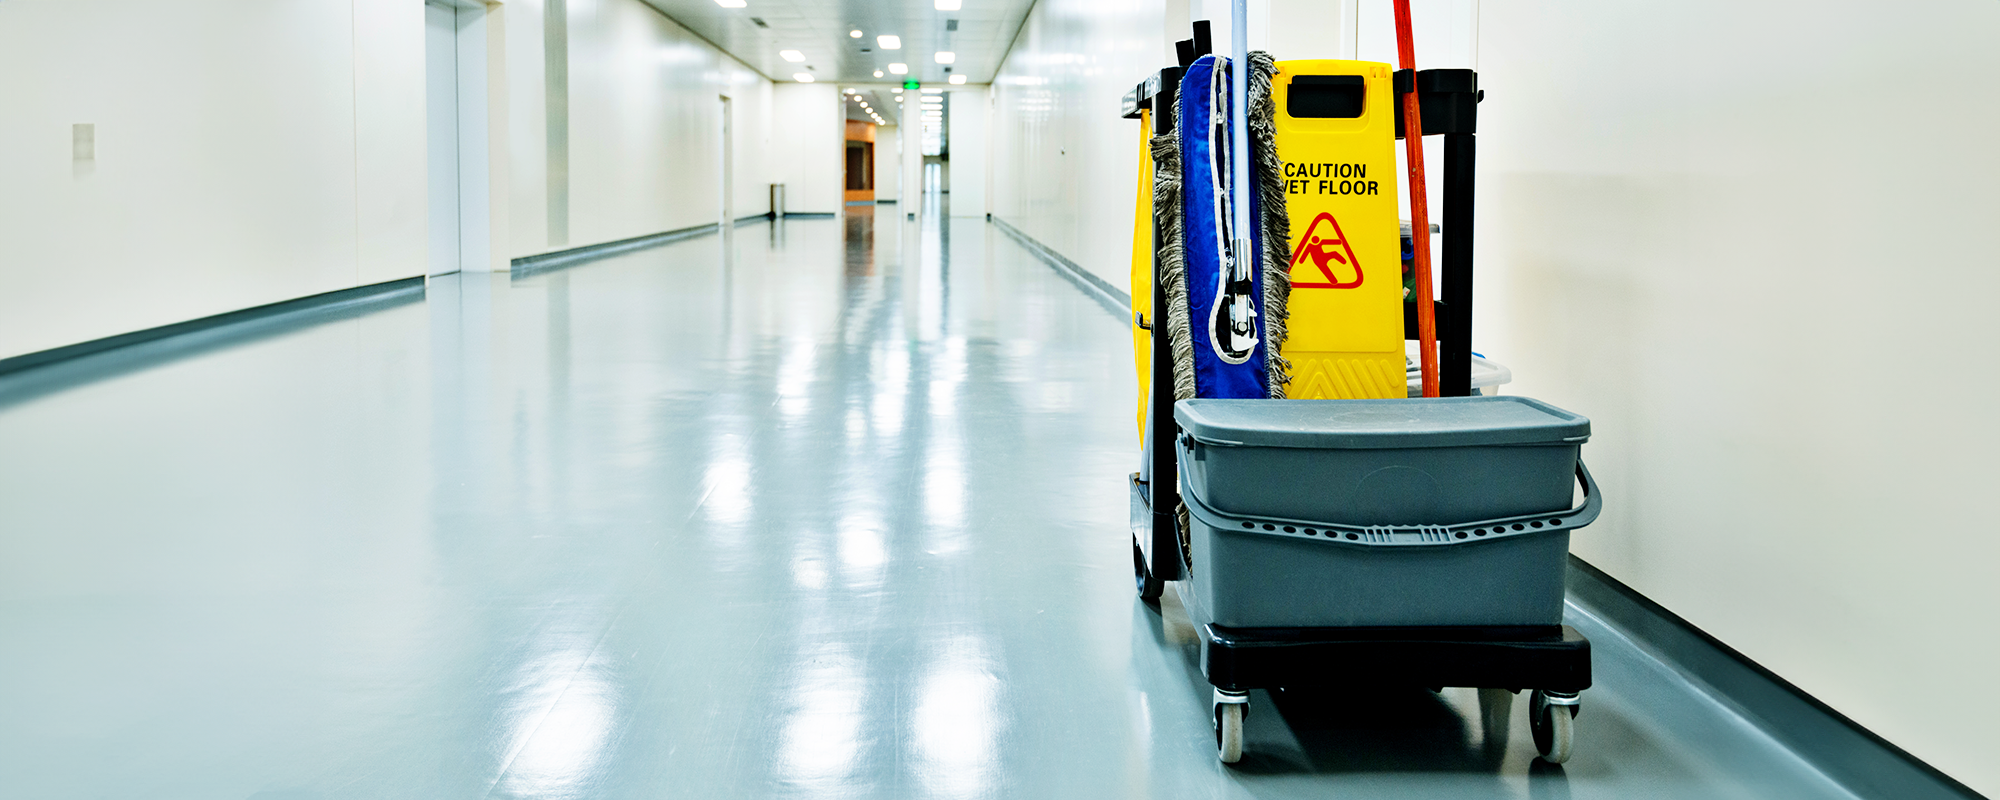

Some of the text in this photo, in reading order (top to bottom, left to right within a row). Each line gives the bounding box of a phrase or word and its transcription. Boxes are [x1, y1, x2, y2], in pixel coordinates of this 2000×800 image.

[1284, 163, 1366, 178] CAUTION
[1284, 180, 1378, 195] ET FLOOR
